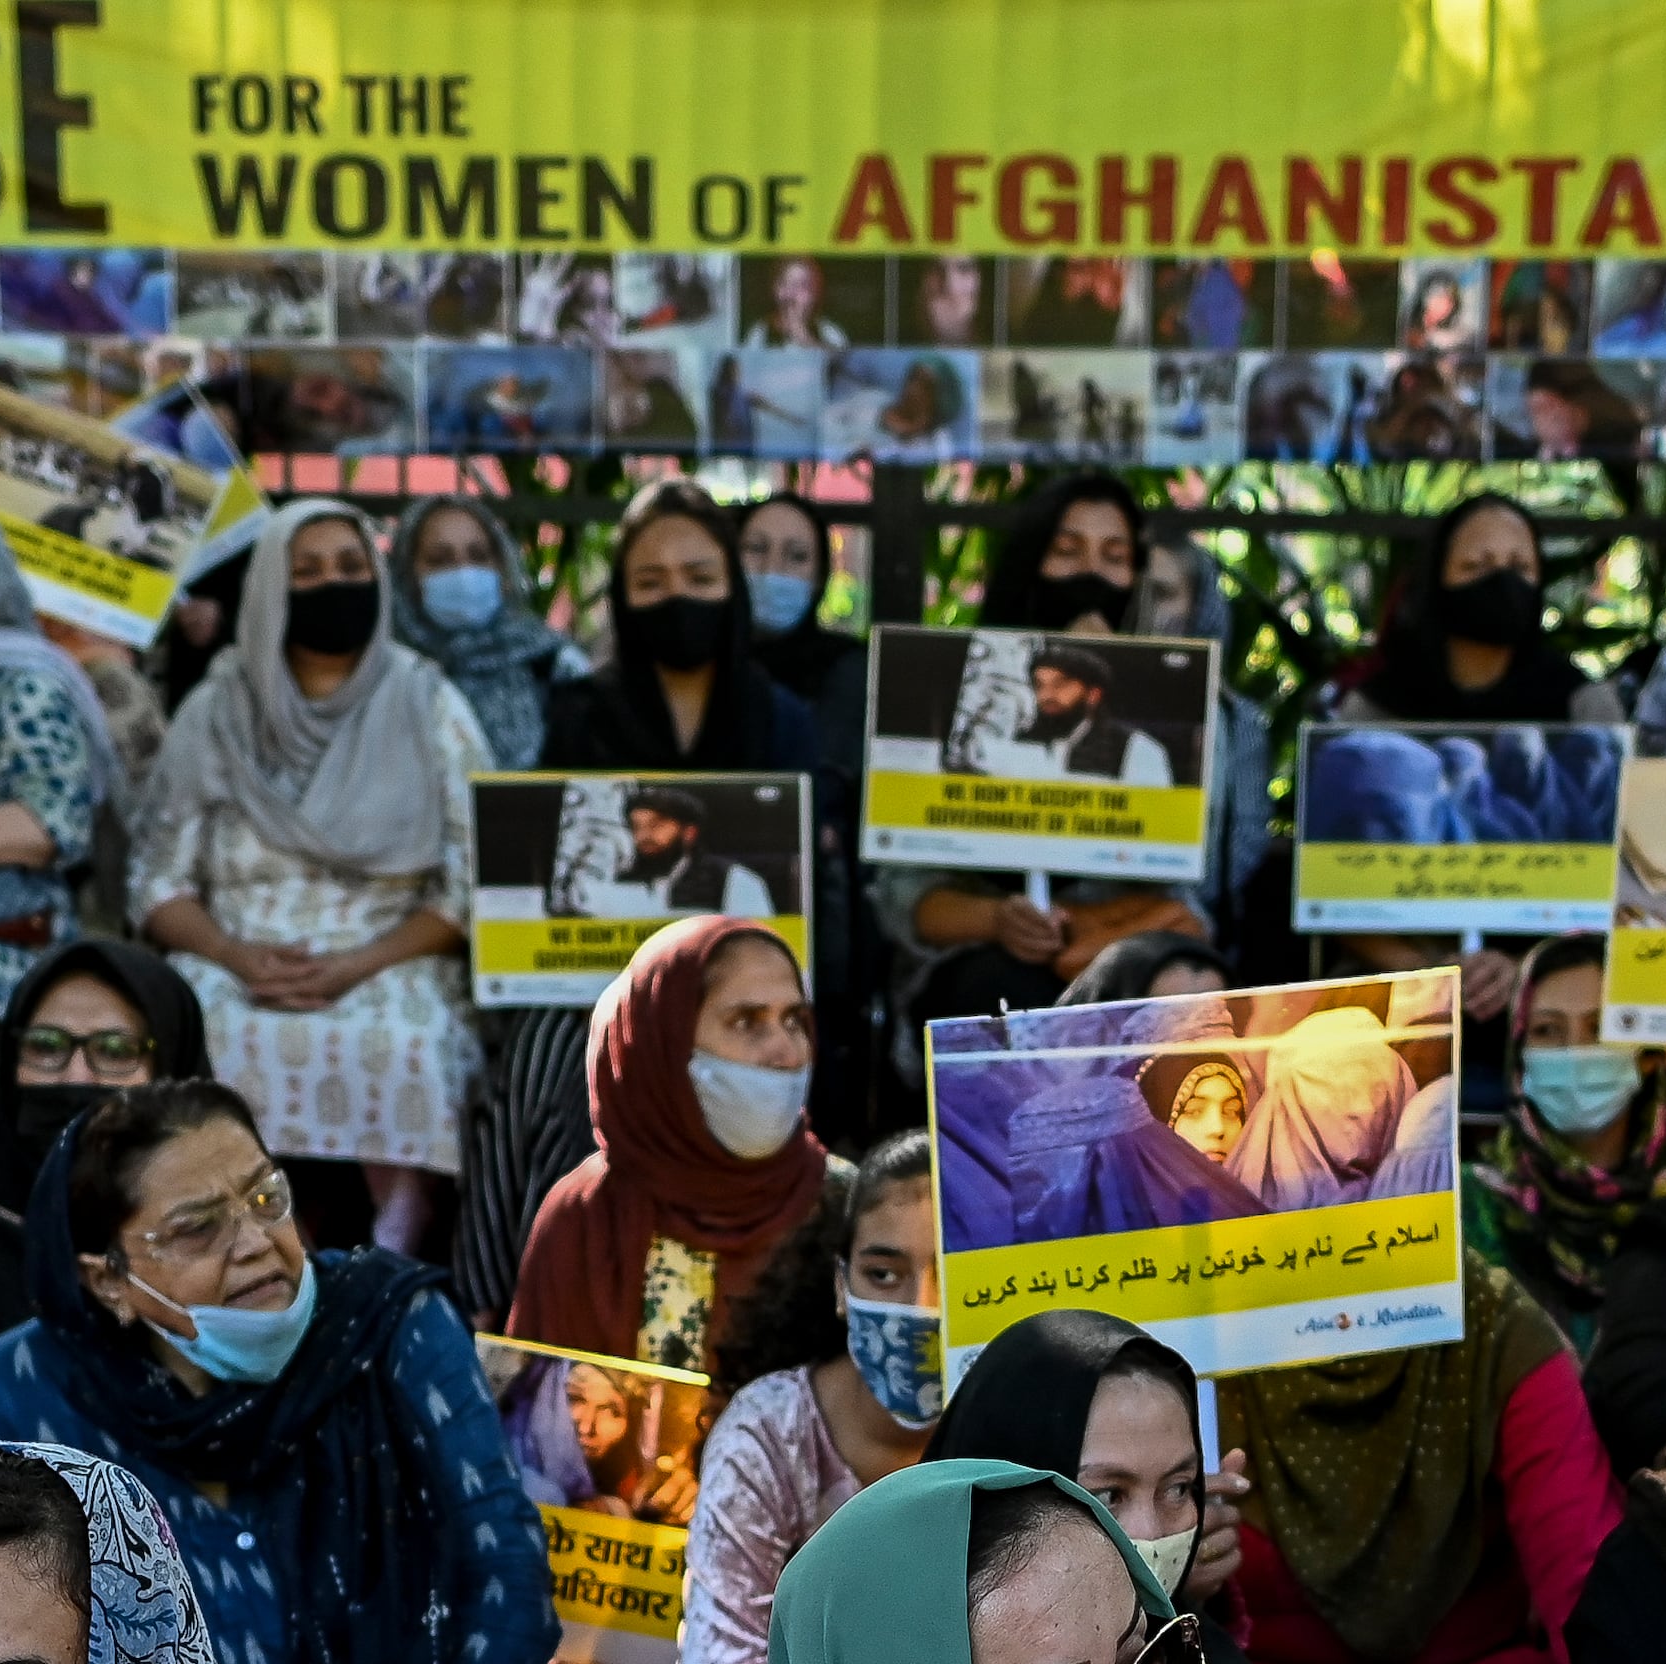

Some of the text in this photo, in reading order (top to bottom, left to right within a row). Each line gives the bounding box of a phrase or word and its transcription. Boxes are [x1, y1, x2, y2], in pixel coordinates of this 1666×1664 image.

[191, 73, 472, 138] FOR THE
[195, 152, 655, 243] WOMEN
[691, 173, 808, 245] OF
[1305, 1235, 1334, 1268] نام
[1341, 1230, 1378, 1266] کے
[1386, 1222, 1440, 1257] اسلام
[1118, 1256, 1158, 1290] ظلم
[585, 1532, 654, 1573] साथ
